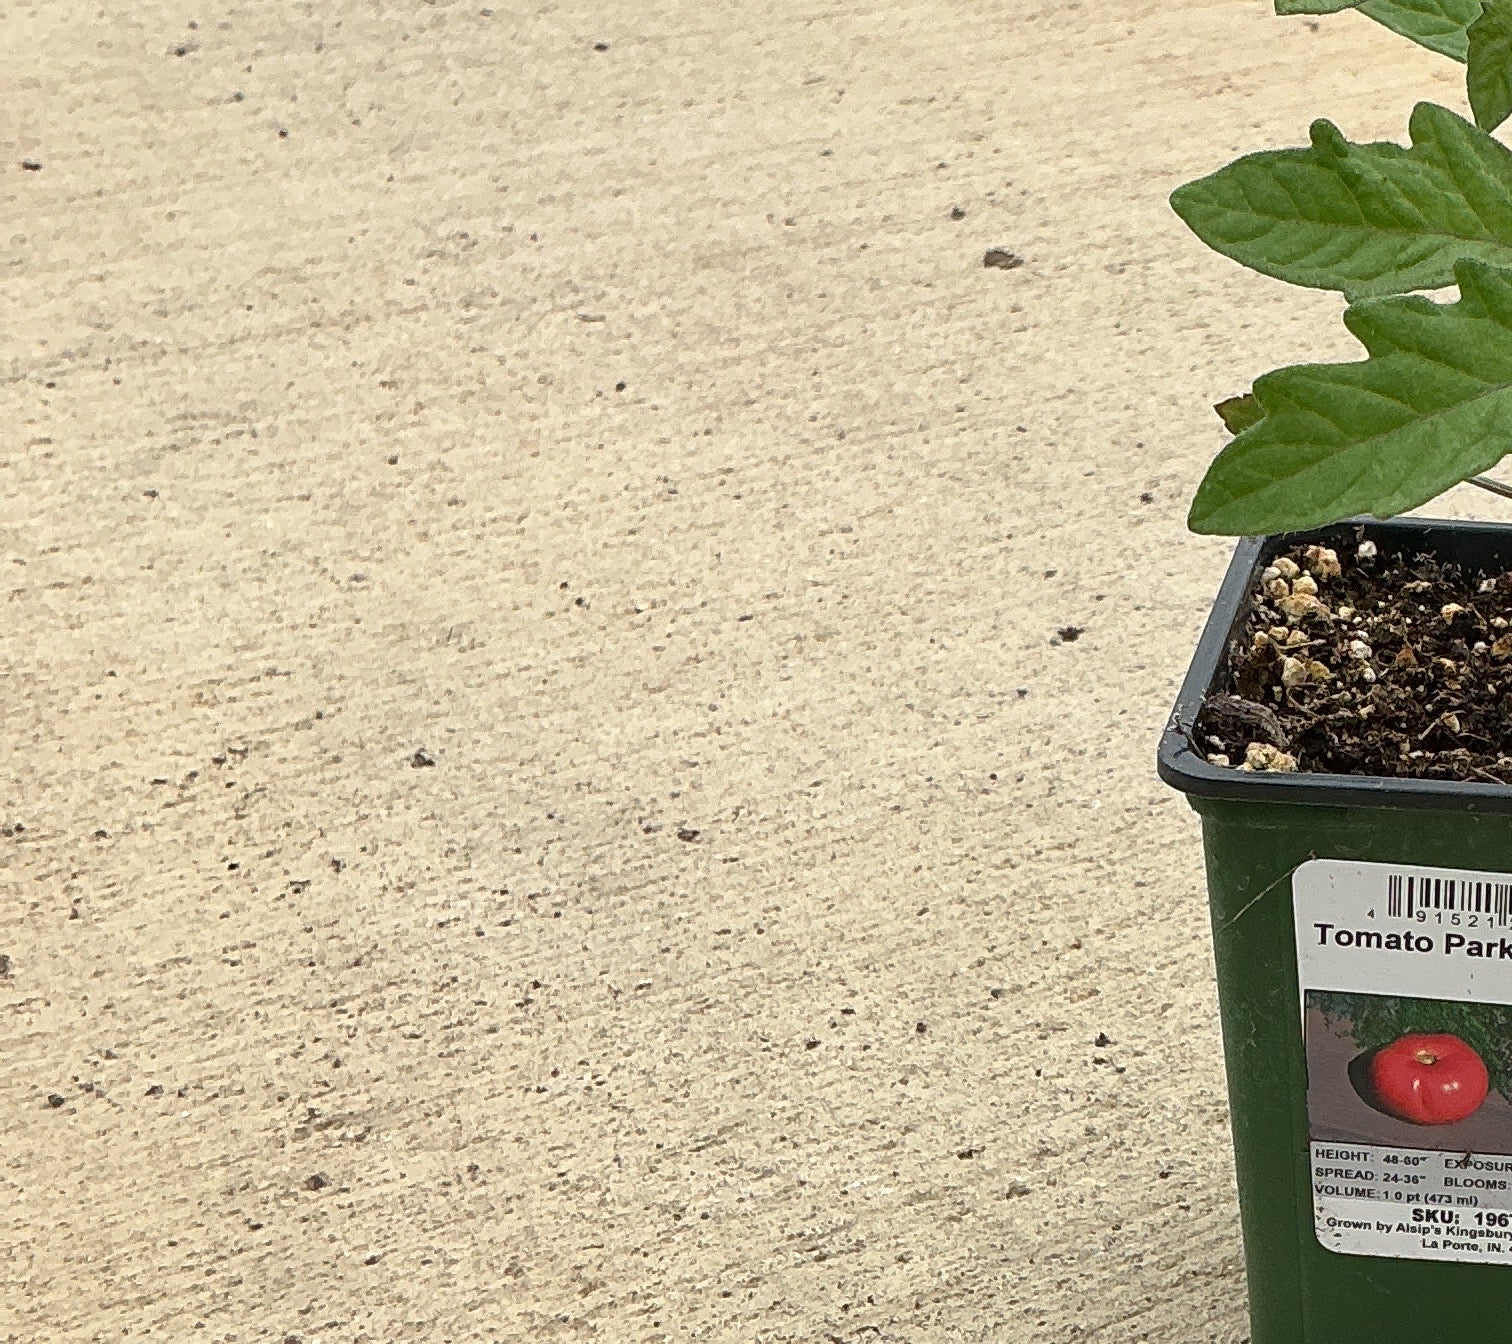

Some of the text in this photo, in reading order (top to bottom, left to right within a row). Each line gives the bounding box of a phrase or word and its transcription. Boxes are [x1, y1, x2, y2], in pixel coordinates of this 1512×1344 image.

[1367, 908, 1375, 919] 4
[1416, 910, 1494, 929] 91521
[1313, 923, 1434, 953] Tomato
[1315, 1148, 1375, 1163] HEIGHT:
[1314, 1167, 1379, 1182] SPREAD:
[1444, 1177, 1512, 1191] BLOOMS:
[1314, 1184, 1380, 1199] VOLUME:
[1406, 1192, 1421, 1204] pt
[1424, 1192, 1453, 1205] (473
[1456, 1195, 1479, 1207] ml)
[1411, 1207, 1460, 1225] SKU:
[1326, 1216, 1372, 1231] Grown
[1376, 1220, 1393, 1234] by
[1395, 1221, 1442, 1237] Alsip's
[1421, 1238, 1439, 1250] La
[1442, 1239, 1483, 1254] Porte,
[1486, 1242, 1506, 1254] IN.
